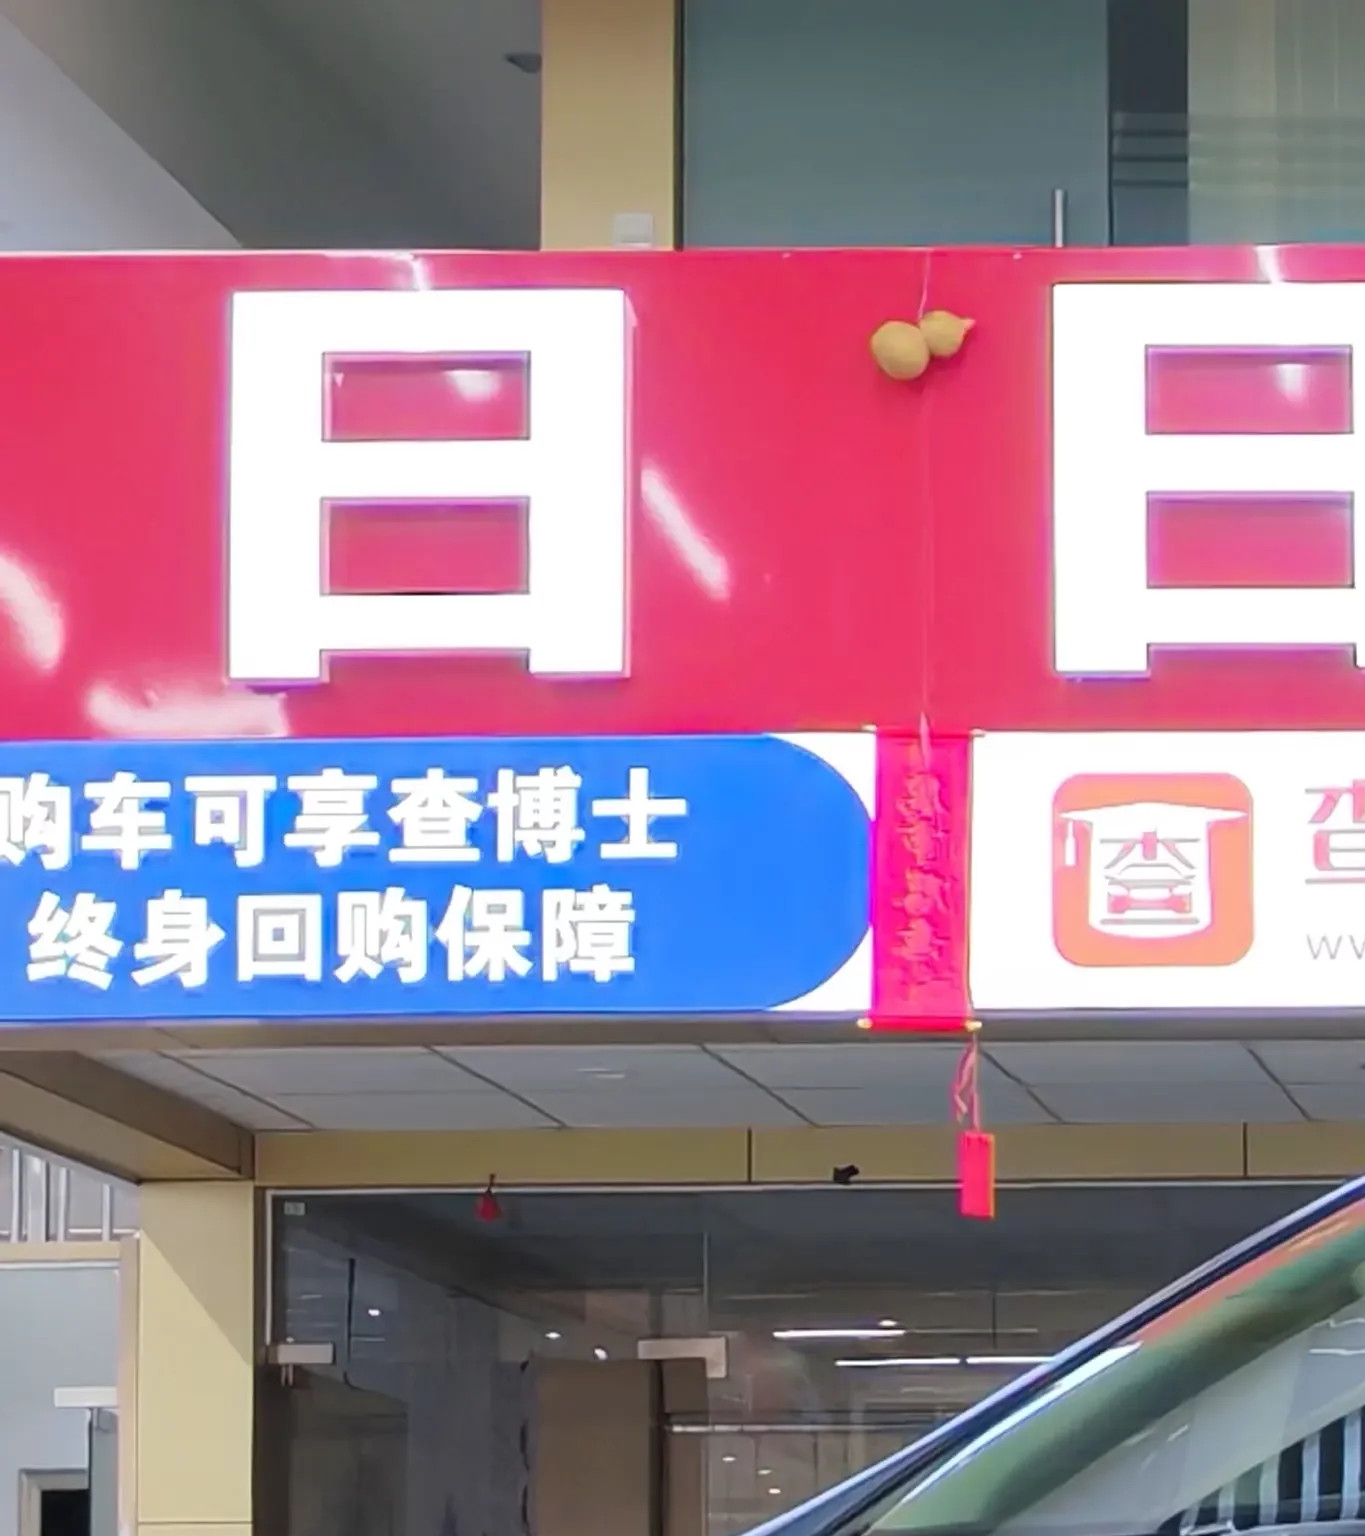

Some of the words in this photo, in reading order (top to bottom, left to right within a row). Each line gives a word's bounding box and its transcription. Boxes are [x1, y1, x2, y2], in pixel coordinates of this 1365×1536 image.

[0, 766, 688, 871] 购车可享查博士
[27, 885, 637, 990] 终身回购保障
